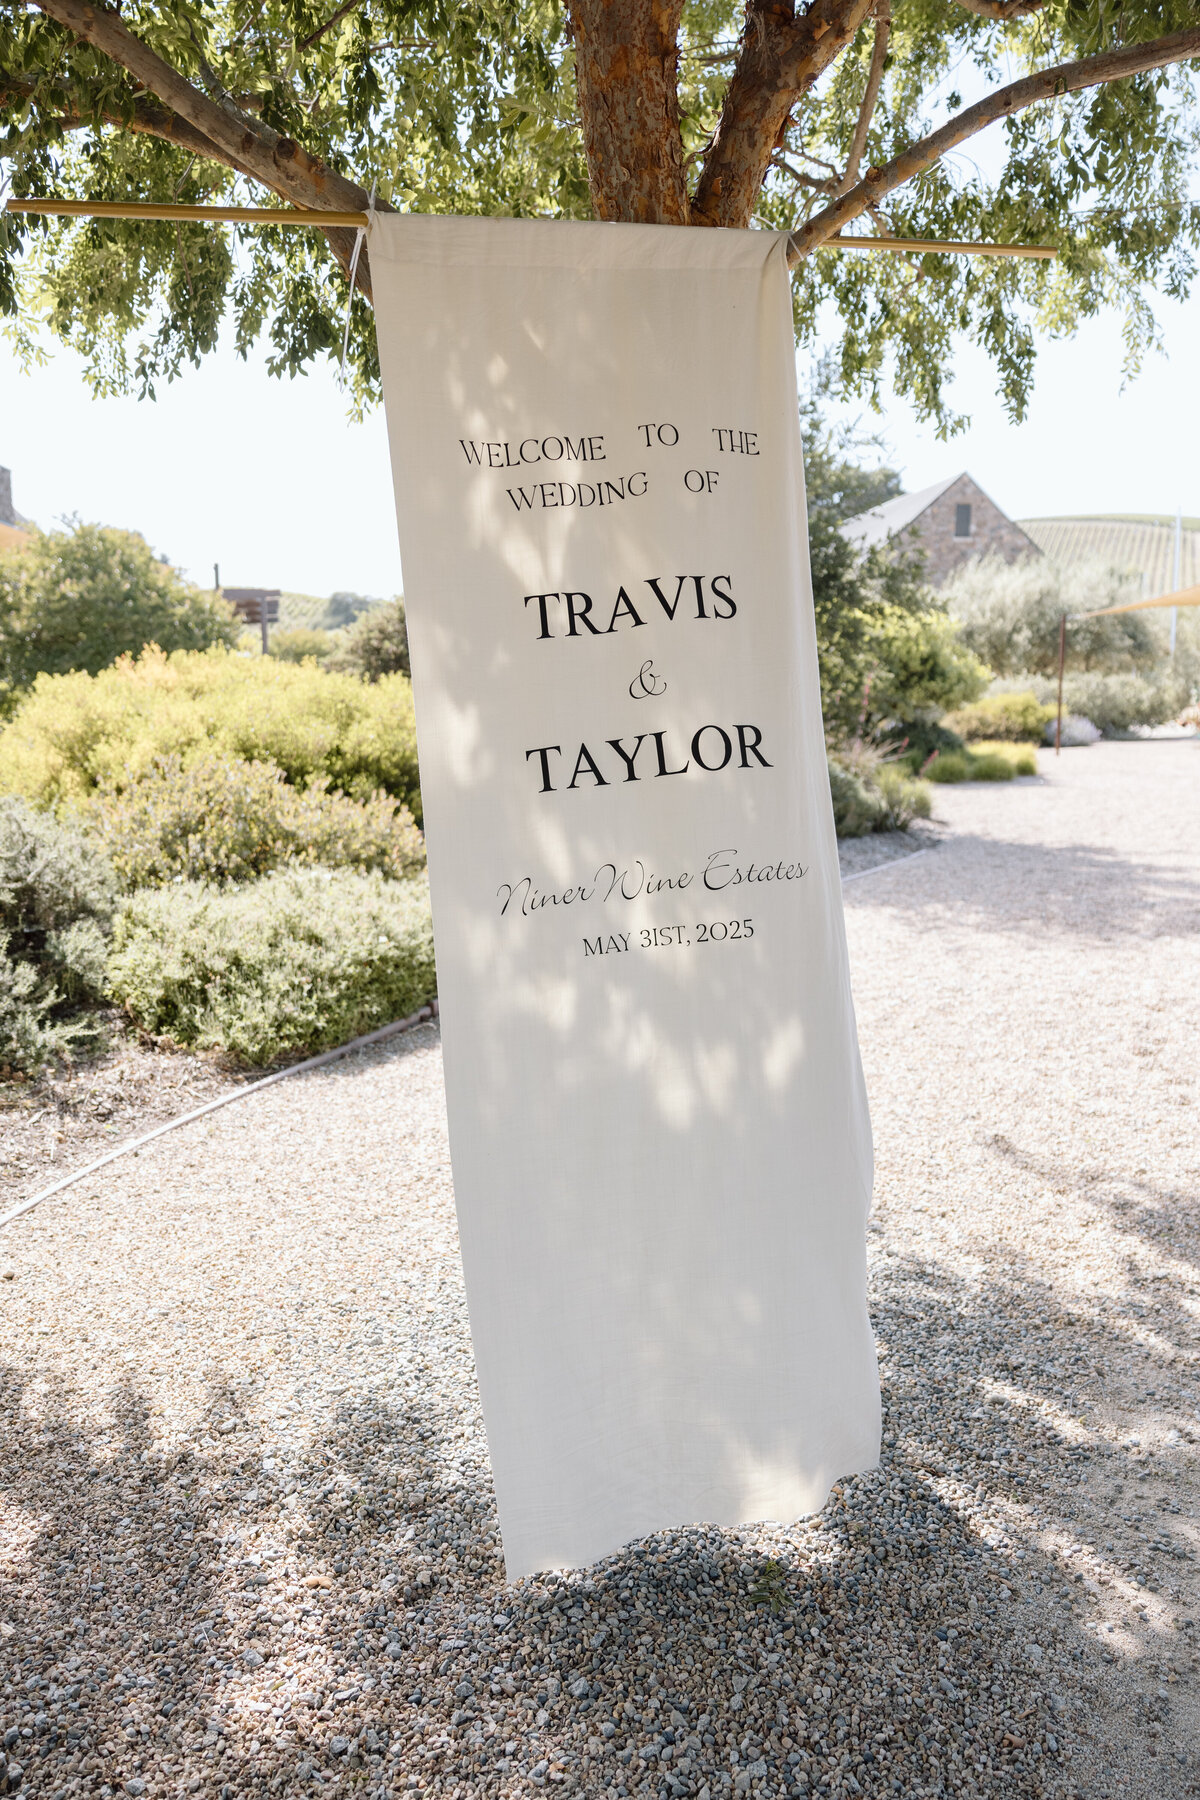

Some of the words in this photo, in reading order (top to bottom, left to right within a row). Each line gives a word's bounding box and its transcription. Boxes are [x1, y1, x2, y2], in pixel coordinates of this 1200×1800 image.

[459, 436, 607, 468] WELCOME
[637, 423, 680, 448] TO
[711, 428, 761, 456] THE
[506, 472, 649, 511] WEDDING
[683, 469, 720, 494] OF
[524, 575, 738, 640] TRAVIS
[629, 660, 667, 700] &
[525, 724, 774, 793] TAYLOR
[496, 877, 595, 916] Niner
[594, 860, 695, 902] Wine
[700, 848, 810, 891] Estates
[583, 932, 632, 957] MAY
[640, 925, 692, 948] 31ST,
[696, 918, 755, 943] 2025
